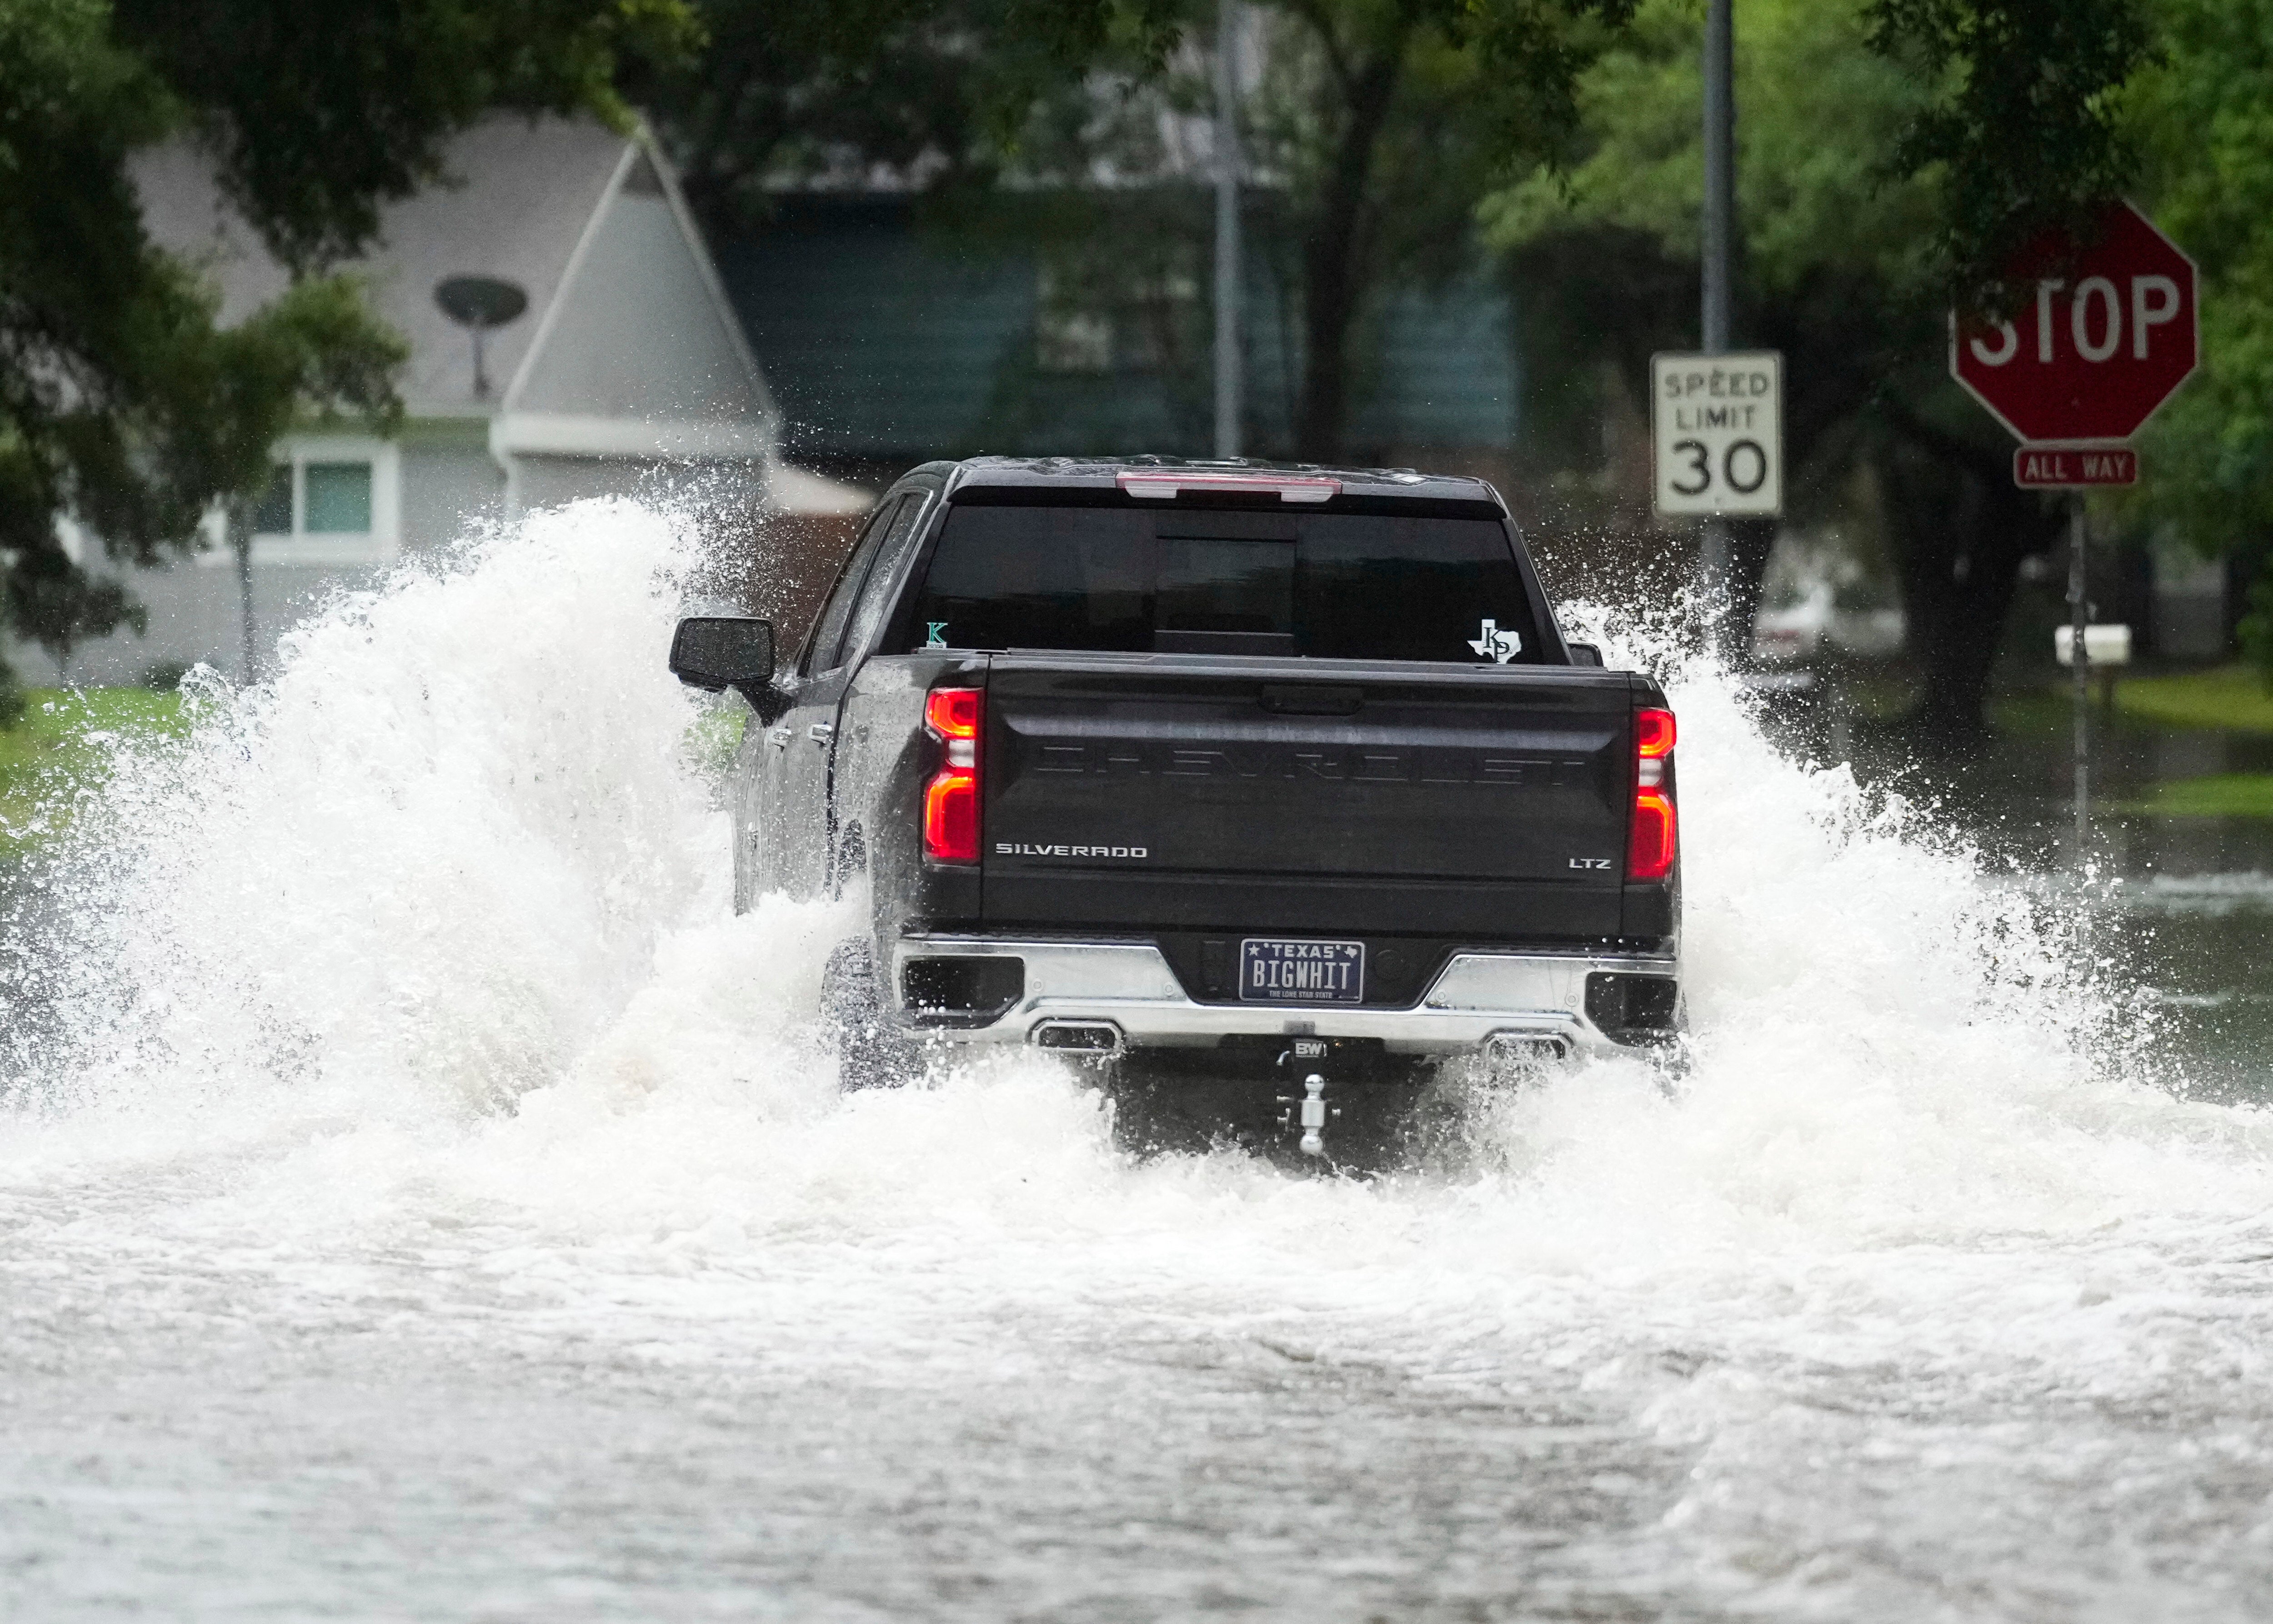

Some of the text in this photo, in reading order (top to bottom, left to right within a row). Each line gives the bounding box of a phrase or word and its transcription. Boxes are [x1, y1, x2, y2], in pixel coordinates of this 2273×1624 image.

[1664, 369, 1769, 398] SPEED
[1676, 405, 1756, 431] LIMIT
[1671, 438, 1766, 496] 30
[2024, 455, 2127, 480] ALL WAY
[996, 843, 1147, 858] SILVERADO
[1569, 858, 1611, 869] LTZ
[1272, 943, 1334, 958] TEXAS
[1252, 959, 1351, 990] BIGWHIT
[1295, 1043, 1322, 1055] BW
